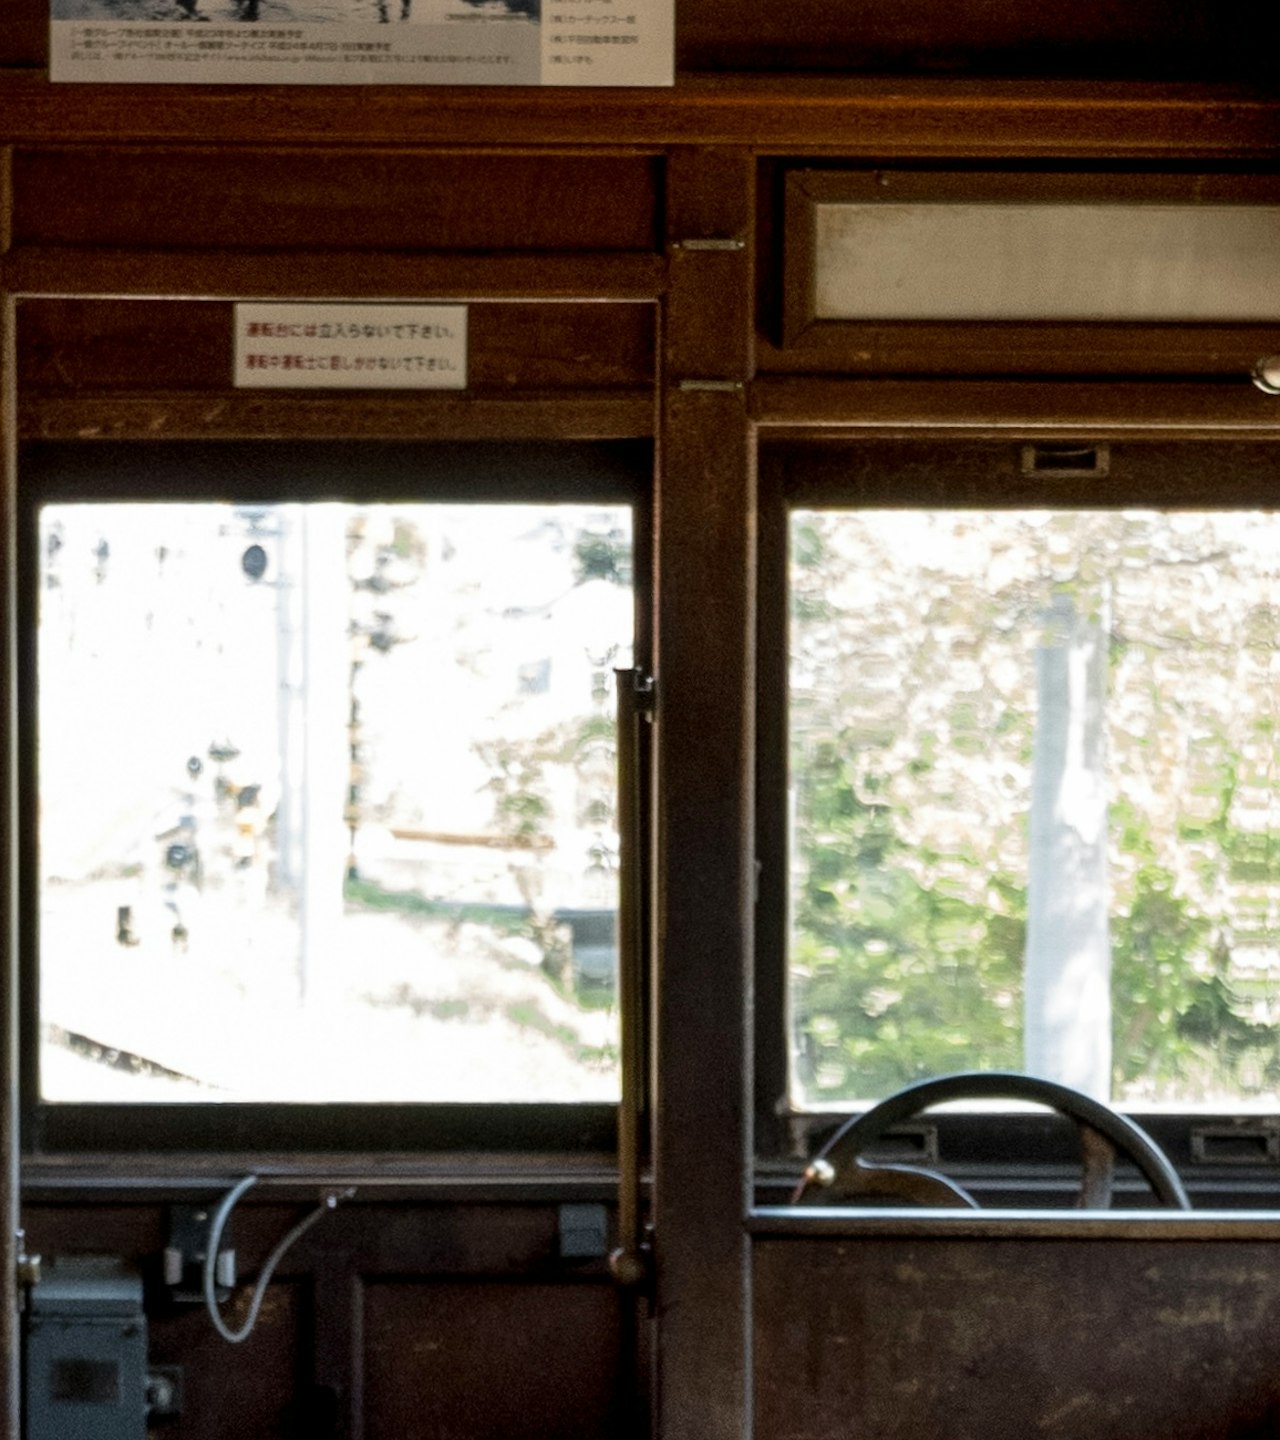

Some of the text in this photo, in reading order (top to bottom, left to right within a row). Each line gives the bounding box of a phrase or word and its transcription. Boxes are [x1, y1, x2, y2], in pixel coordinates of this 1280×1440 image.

[245, 321, 456, 340] 運転台には立入らないで下さい。
